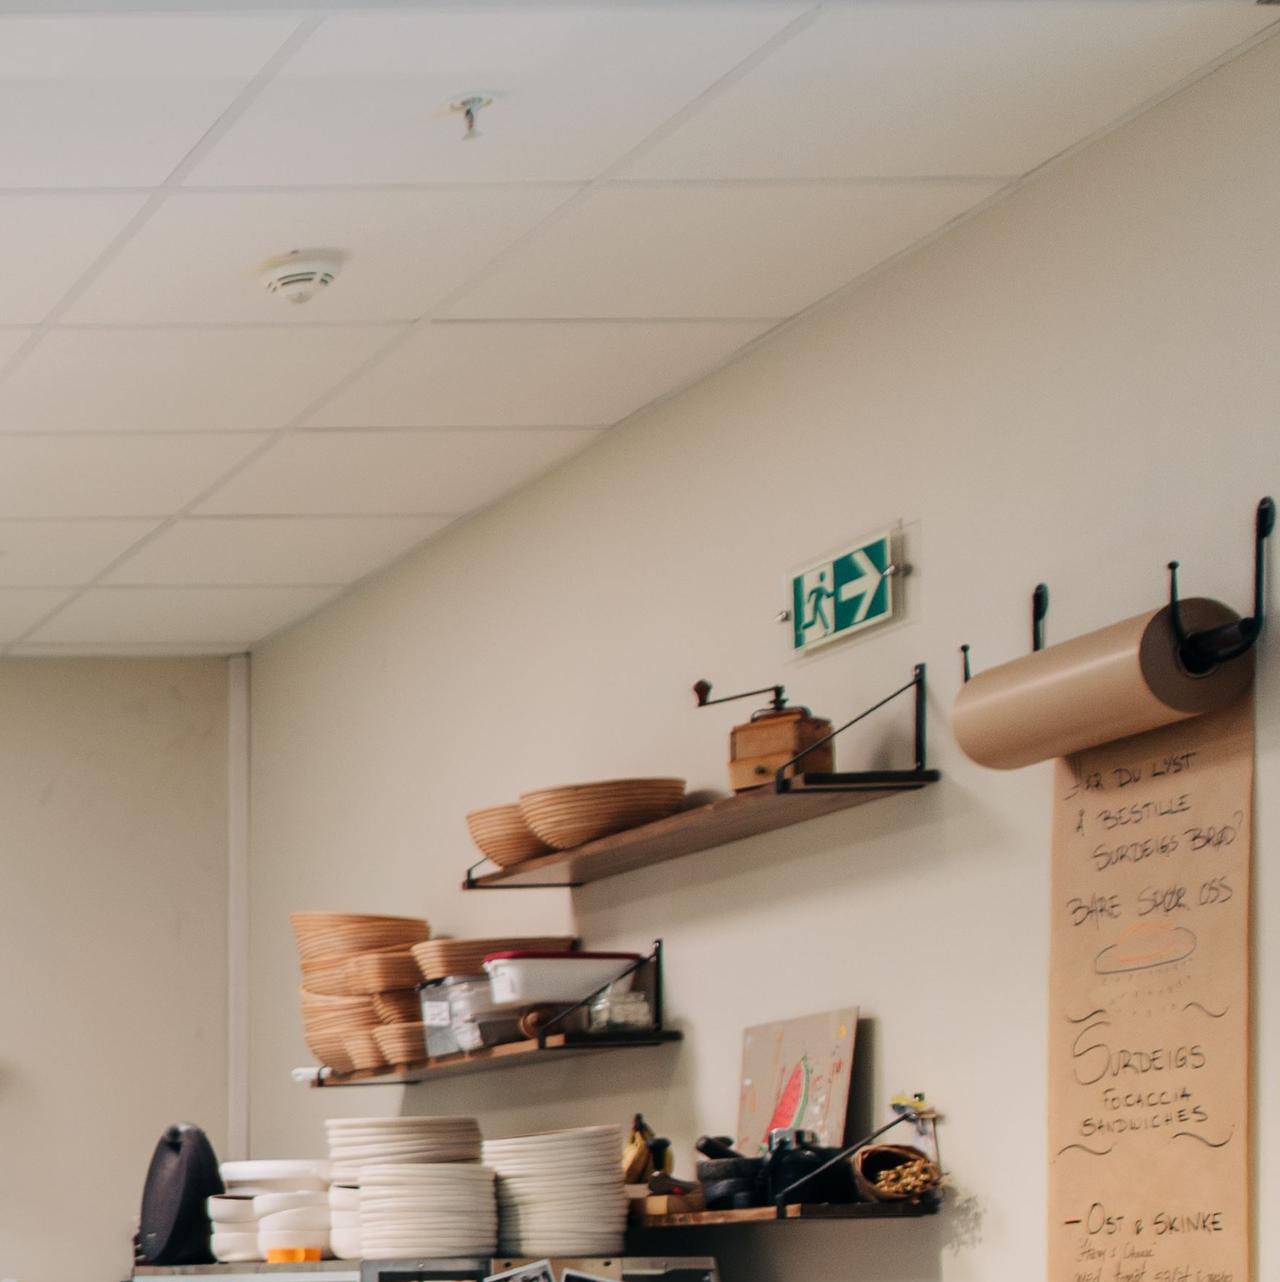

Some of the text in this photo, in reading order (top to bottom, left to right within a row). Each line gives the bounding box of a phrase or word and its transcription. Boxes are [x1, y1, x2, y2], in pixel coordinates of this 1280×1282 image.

[1113, 767, 1140, 787] DU
[1151, 752, 1197, 777] LYST
[1096, 794, 1192, 830] BESTILLE
[1091, 835, 1179, 872] SURDEIGS
[1066, 893, 1121, 927] BARE
[1197, 876, 1233, 907] OSS
[1072, 1021, 1206, 1086] SURDEIGS
[1102, 1087, 1192, 1110] FOCACCIA
[1079, 1106, 1208, 1137] SANDWICHES
[1153, 1211, 1224, 1236] SKINKE
